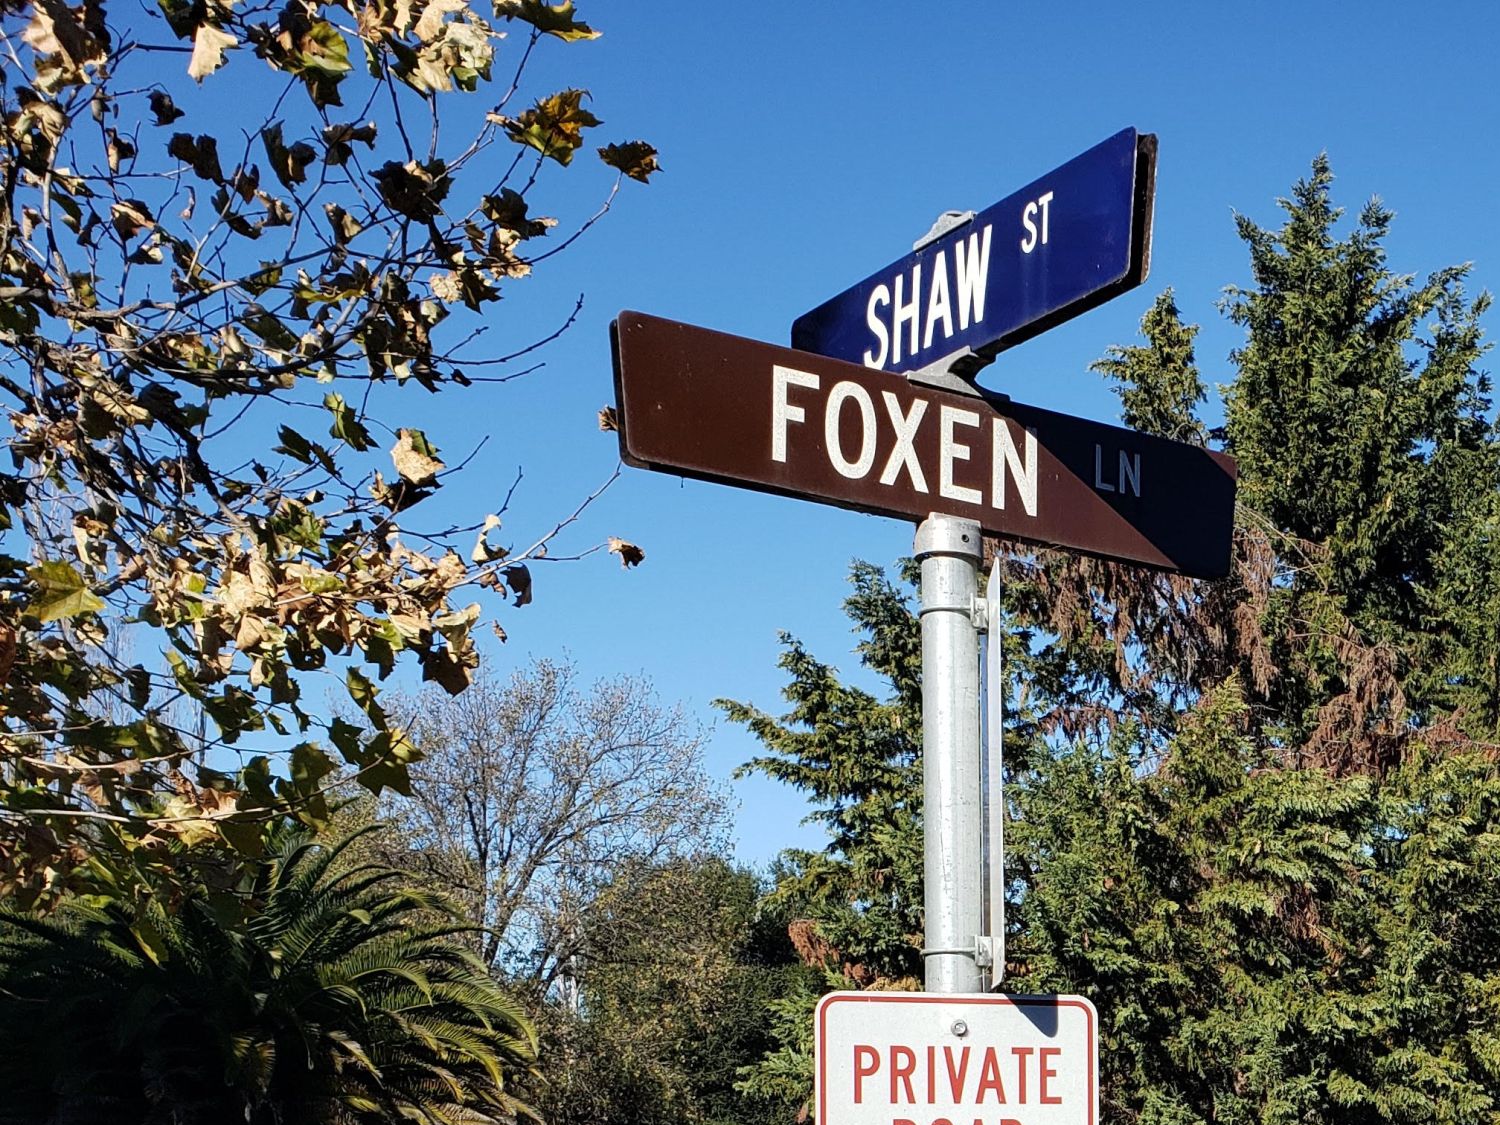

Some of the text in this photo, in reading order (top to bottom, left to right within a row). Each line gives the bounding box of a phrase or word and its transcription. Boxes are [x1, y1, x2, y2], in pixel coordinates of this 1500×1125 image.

[863, 190, 1054, 370] SHAW ST
[771, 364, 1141, 517] FOXEN LN
[853, 1045, 1062, 1104] PRIVATE
